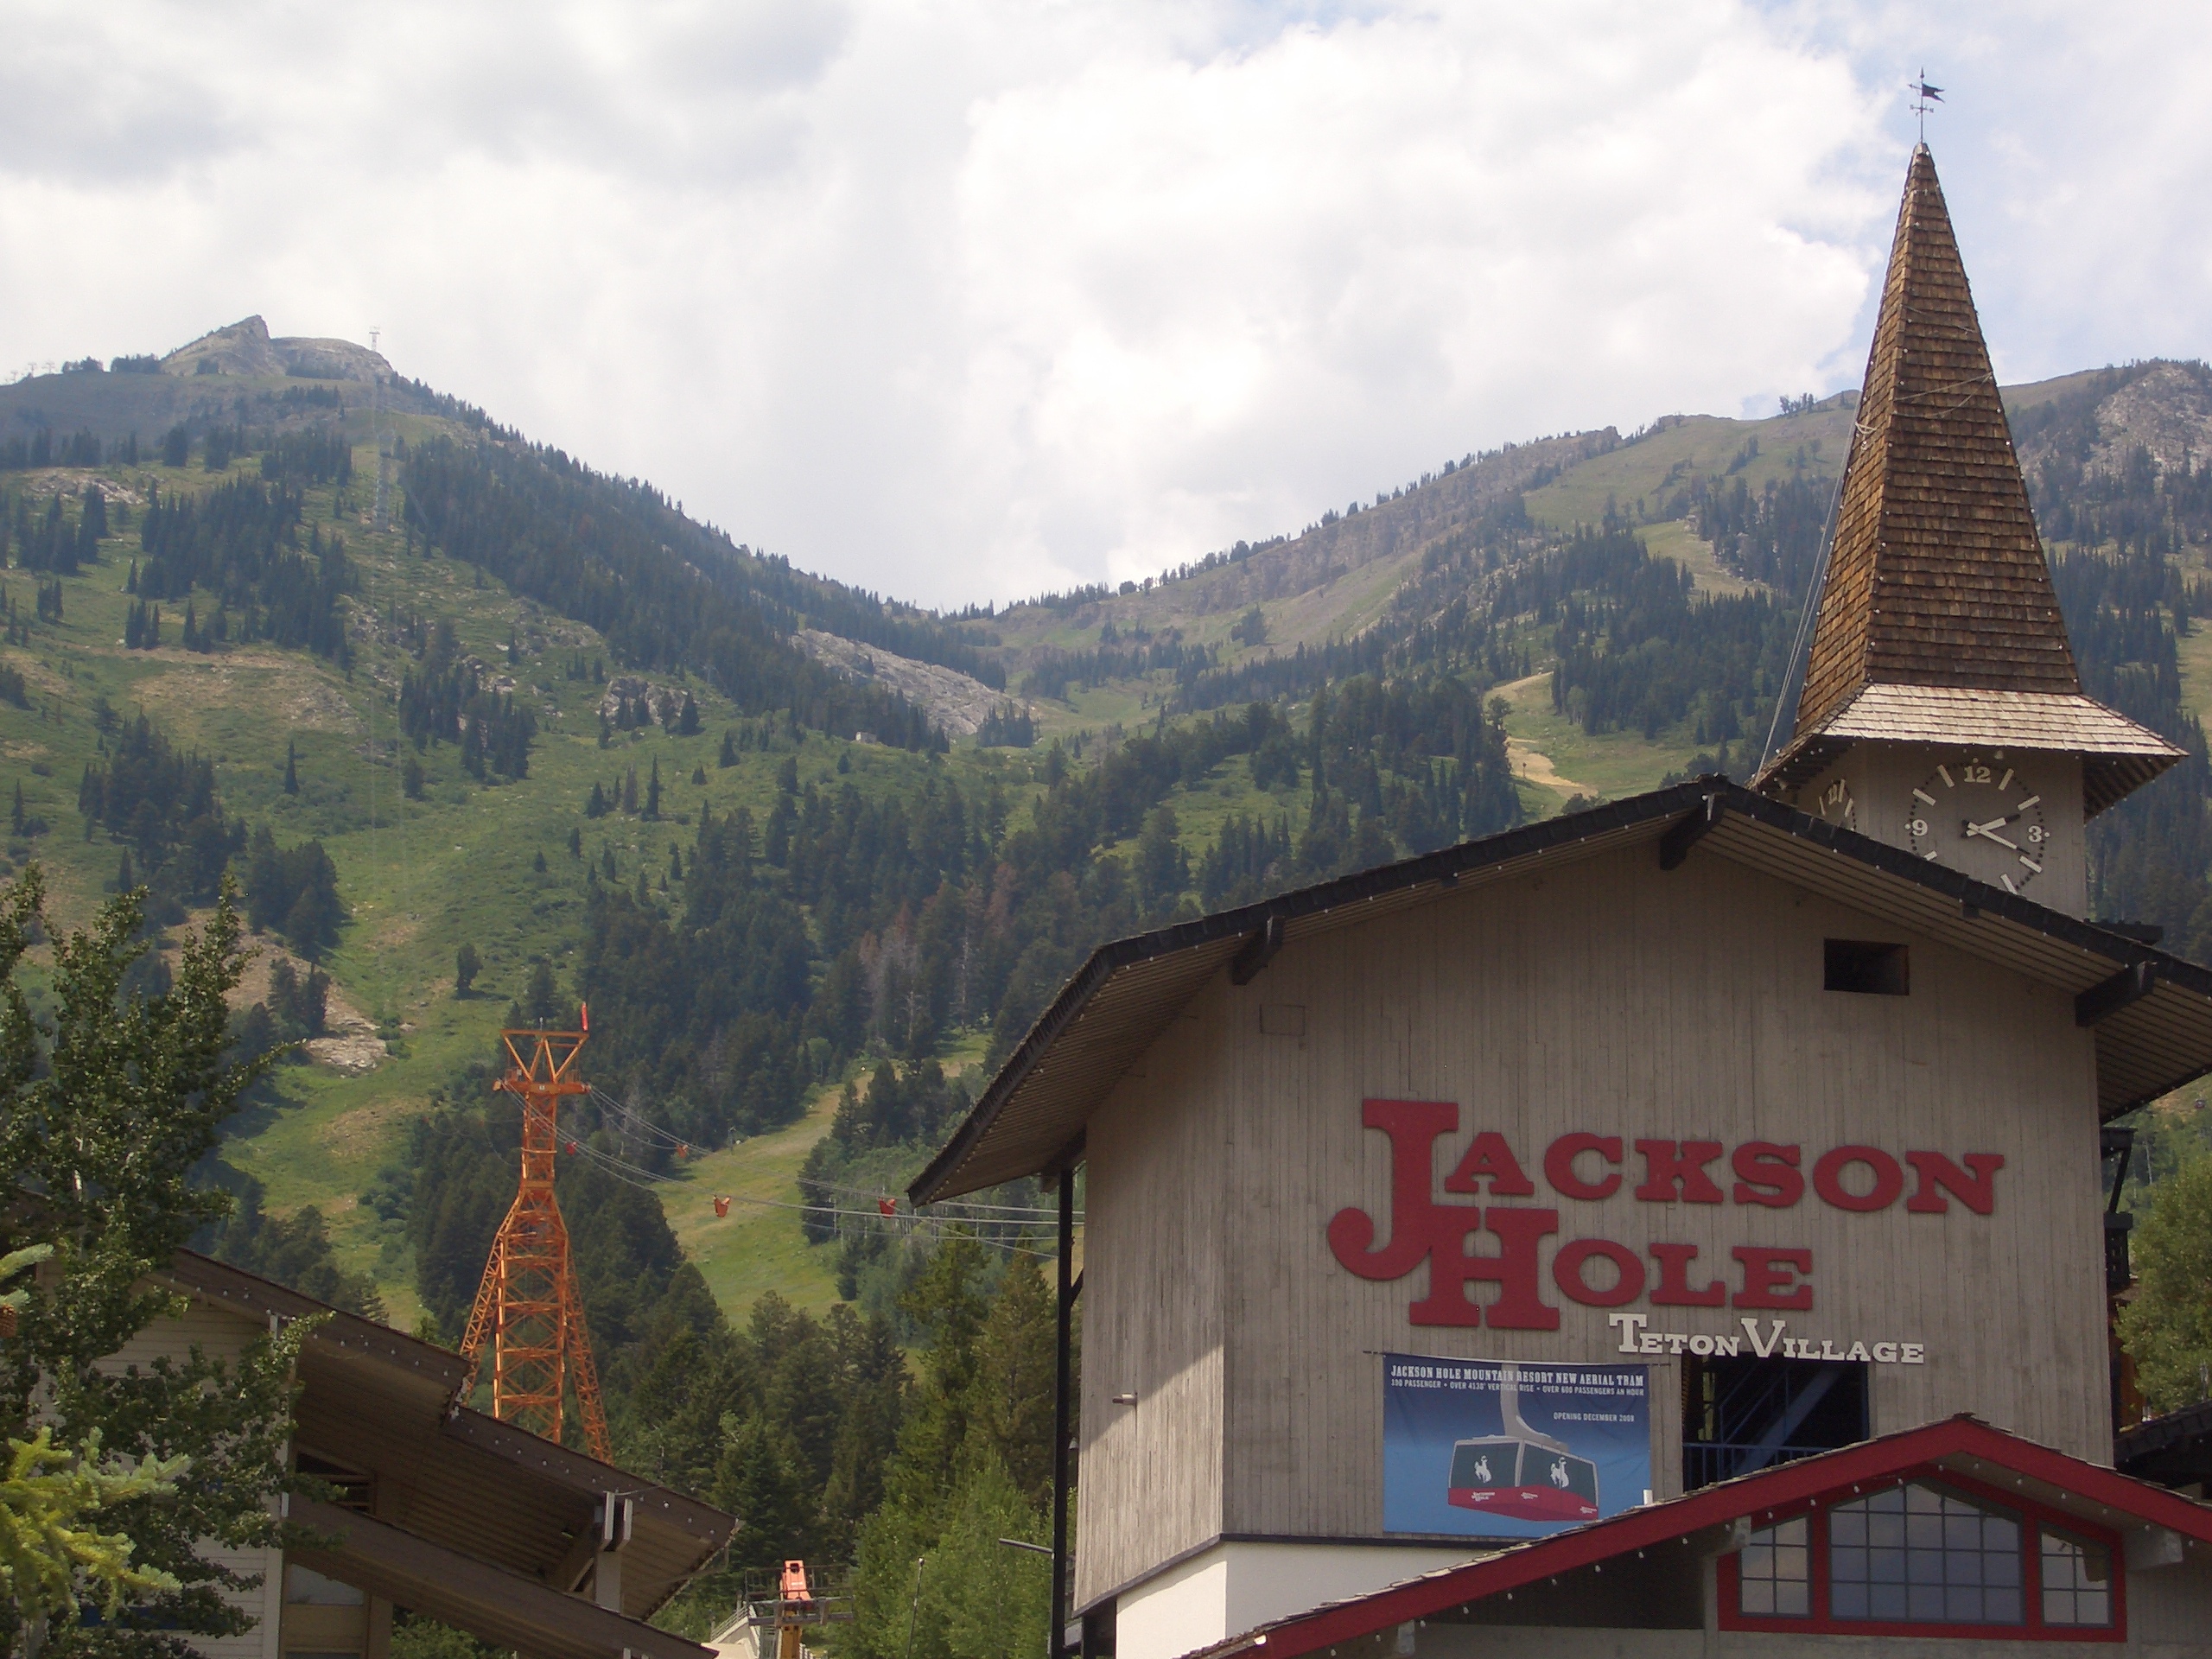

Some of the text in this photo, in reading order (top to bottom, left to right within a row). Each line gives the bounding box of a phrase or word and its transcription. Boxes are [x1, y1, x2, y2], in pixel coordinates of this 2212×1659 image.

[1963, 766, 1991, 783] 12
[1911, 819, 1929, 836] 9
[2028, 825, 2043, 842] 3
[1327, 1098, 2005, 1281] JACKSON
[1409, 1206, 1813, 1331] HOLE
[1609, 1313, 1925, 1364] TETON VILLAGE
[1390, 1365, 1644, 1387] JACKSON HOLE MOUNTAIN RESORT NEW AERIAL TRAM
[1404, 1379, 1441, 1389] PASSENGER
[1449, 1382, 1467, 1390] OVER
[1573, 1386, 1615, 1395] PASSENGERS
[1626, 1388, 1644, 1396] HOUR
[1553, 1412, 1582, 1421] OPENING
[1583, 1413, 1618, 1421] DECEMBER
